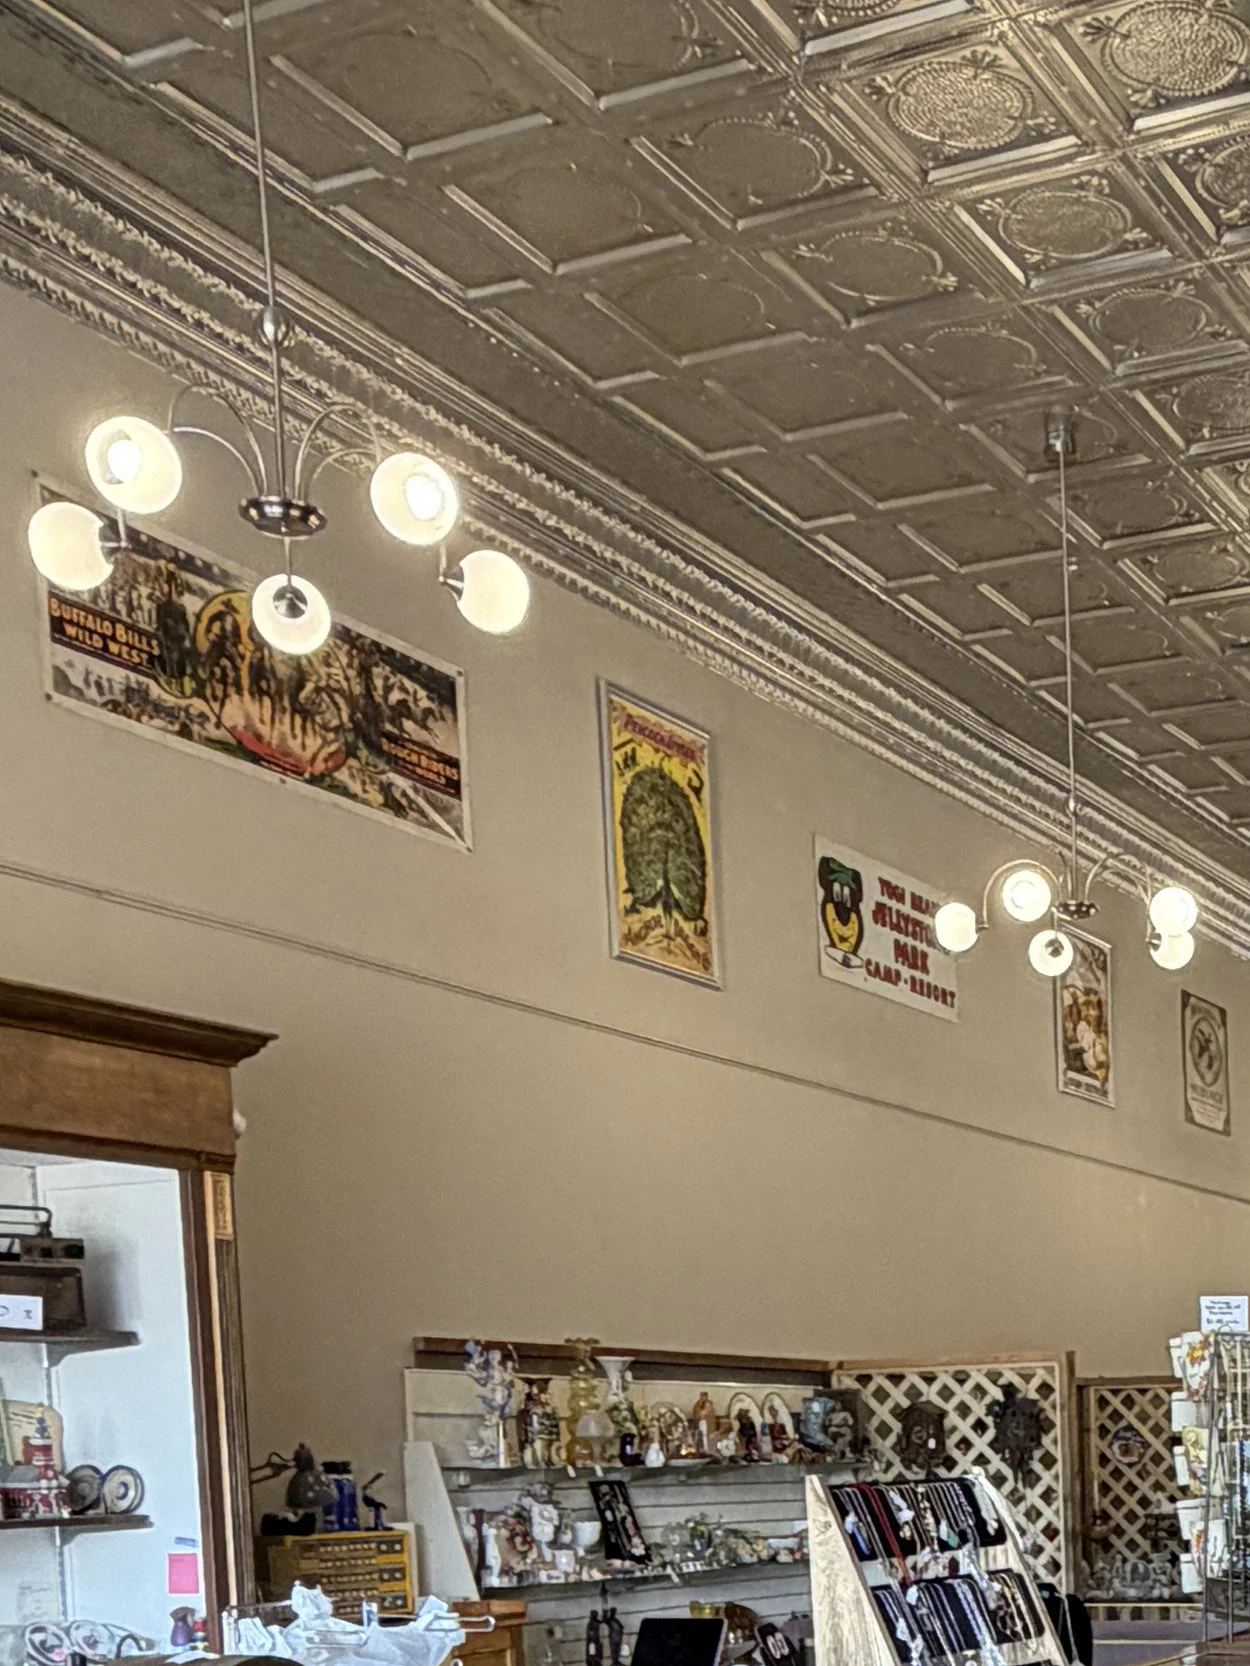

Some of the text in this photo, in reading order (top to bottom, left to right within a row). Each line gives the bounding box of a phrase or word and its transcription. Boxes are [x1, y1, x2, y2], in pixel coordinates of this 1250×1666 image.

[49, 597, 114, 637] BUFFALO
[62, 621, 150, 667] WILD WEST
[878, 876, 905, 905] YOGI
[872, 901, 950, 956] JELLYSTO
[893, 938, 930, 976] PARK
